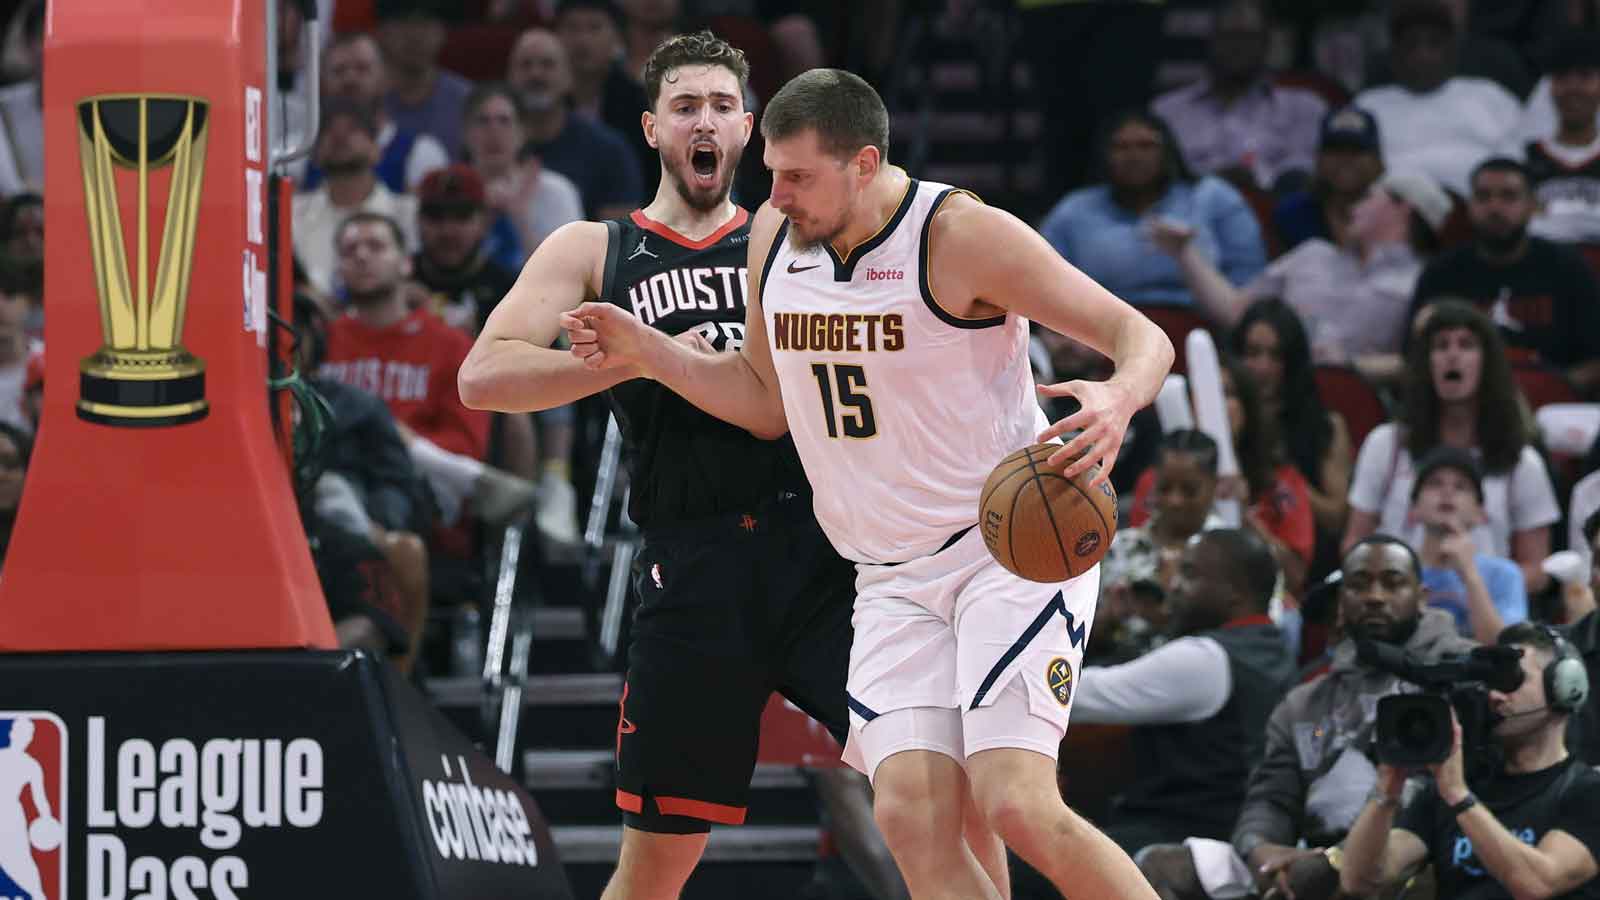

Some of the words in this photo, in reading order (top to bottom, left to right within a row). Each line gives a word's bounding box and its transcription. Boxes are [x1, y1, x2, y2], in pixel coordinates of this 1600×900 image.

[866, 268, 904, 281] ibotta
[773, 312, 905, 352] NUGGETS
[810, 361, 879, 440] 15
[87, 716, 324, 849] League
[422, 753, 538, 867] coinbase
